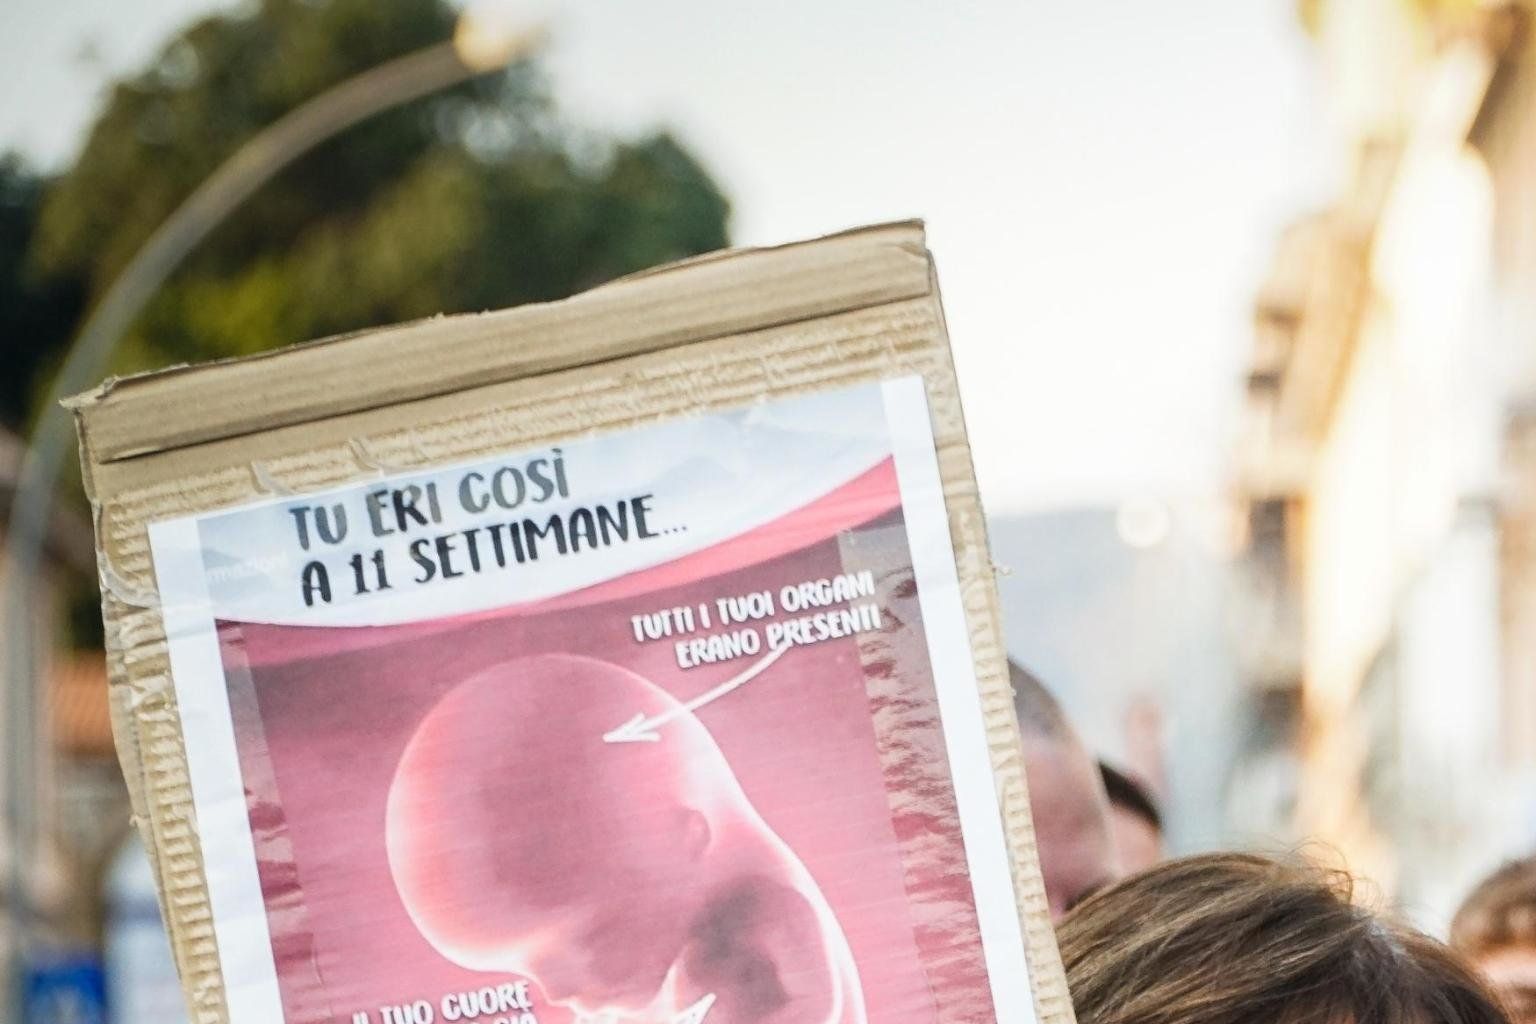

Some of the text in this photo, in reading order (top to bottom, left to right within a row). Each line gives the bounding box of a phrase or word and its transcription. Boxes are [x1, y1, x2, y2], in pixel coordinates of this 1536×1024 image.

[289, 448, 569, 551] TU ERI COSÌ
[302, 560, 332, 607] A
[349, 548, 394, 595] 11
[631, 570, 875, 642] TUTTI I TUOI ORGANI
[675, 603, 881, 669] ERANO PRESENTI
[441, 980, 533, 1021] CUORE
